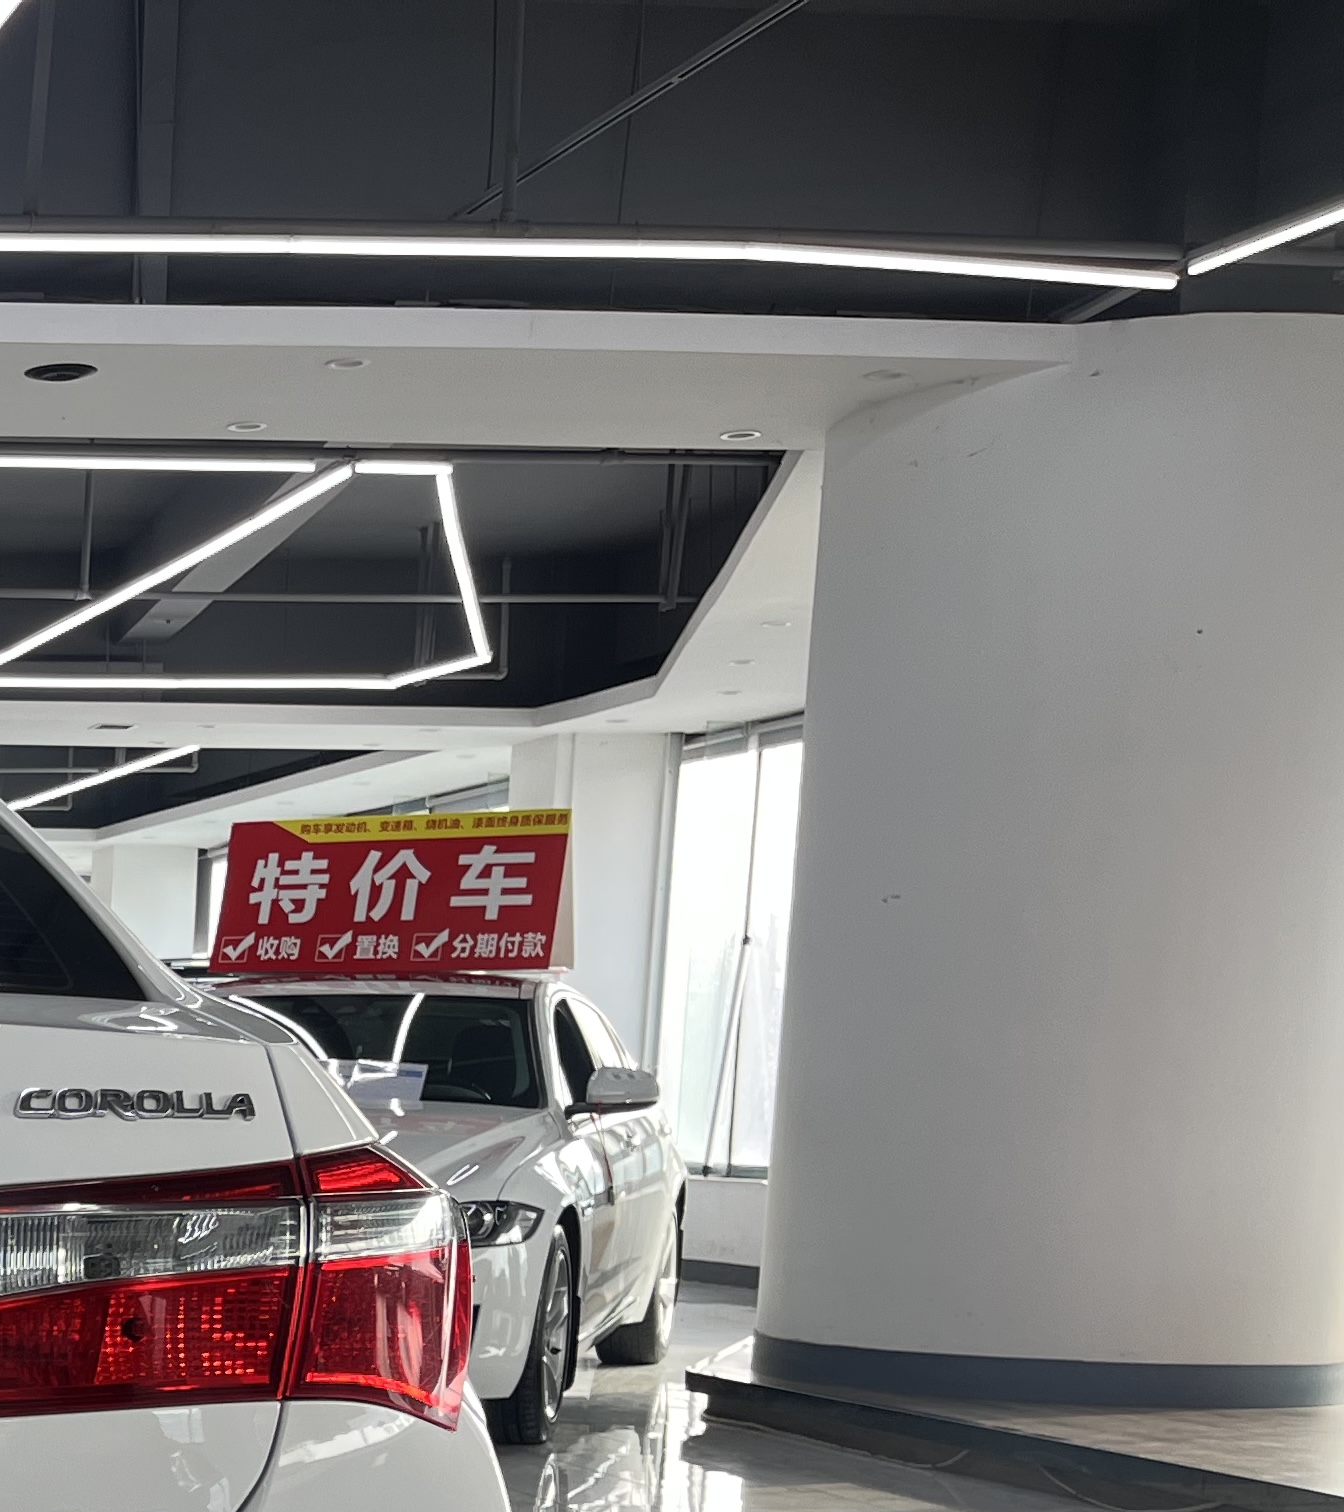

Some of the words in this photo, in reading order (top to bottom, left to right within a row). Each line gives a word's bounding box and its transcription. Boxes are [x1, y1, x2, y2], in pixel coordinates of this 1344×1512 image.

[248, 845, 536, 925] 特价车
[257, 933, 301, 961] 收购
[353, 934, 400, 960] 置换
[450, 932, 547, 960] 分期付款
[13, 1087, 256, 1121] COROLLA
